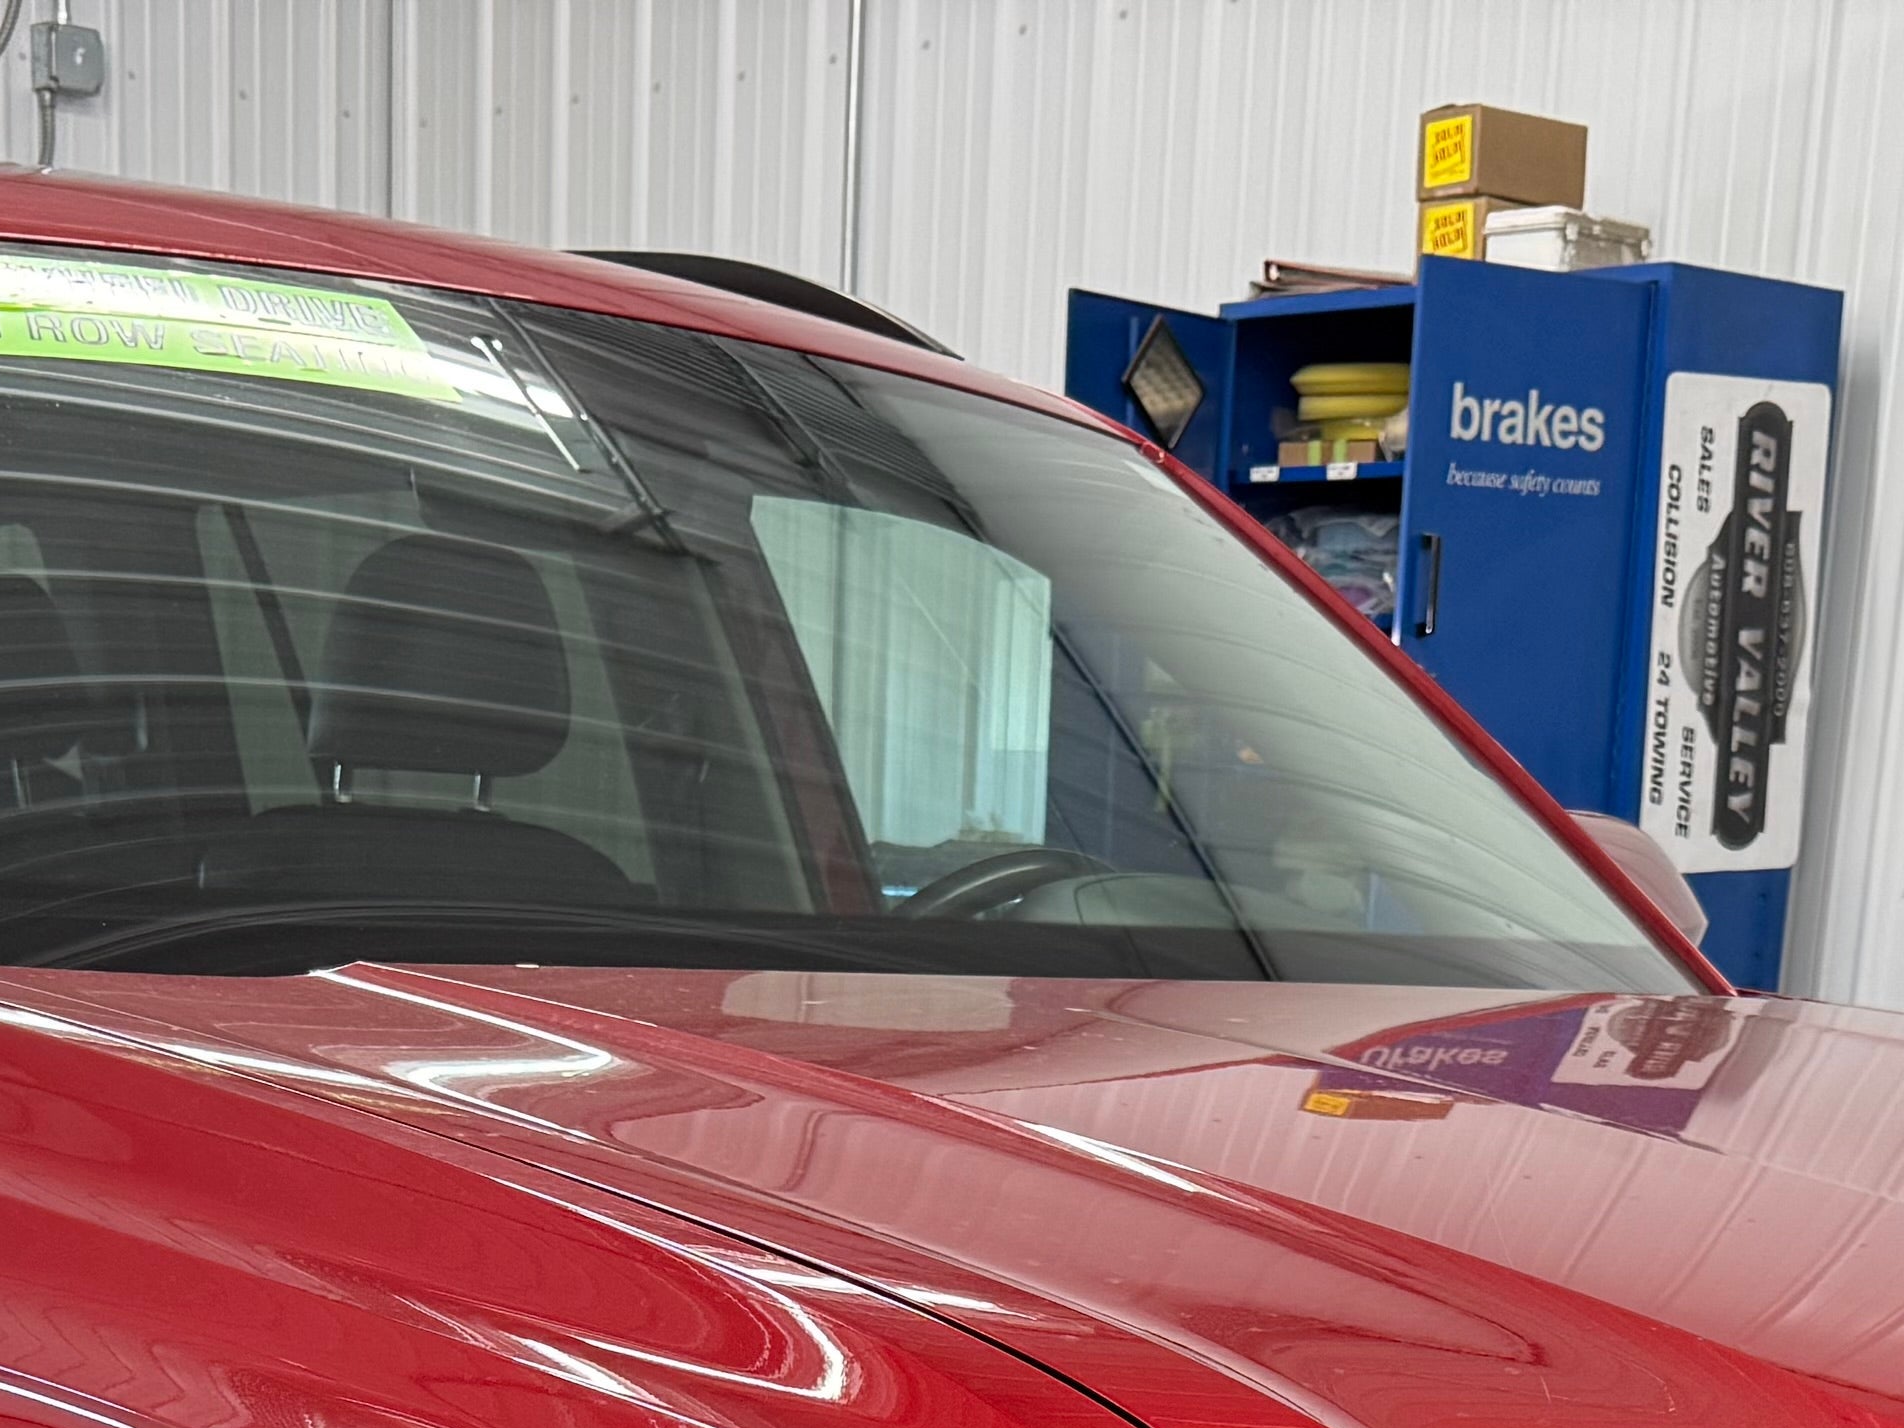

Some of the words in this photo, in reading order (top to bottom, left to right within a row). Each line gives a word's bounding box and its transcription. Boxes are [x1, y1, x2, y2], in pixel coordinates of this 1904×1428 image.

[25, 311, 166, 351] ROW
[218, 284, 386, 337] DRIVE
[1450, 381, 1605, 452] brakes
[1446, 462, 1507, 488] because
[1510, 469, 1550, 497] safety
[1552, 476, 1600, 496] counts
[1696, 425, 1716, 514] SALES
[1741, 430, 1778, 598] RIVER
[1661, 464, 1682, 608] COLLISION
[1657, 651, 1672, 687] 24
[1702, 554, 1727, 706] Automotive
[1649, 698, 1669, 806] TOWING
[1727, 629, 1765, 824] VALLEY
[1675, 726, 1695, 838] SERVICE
